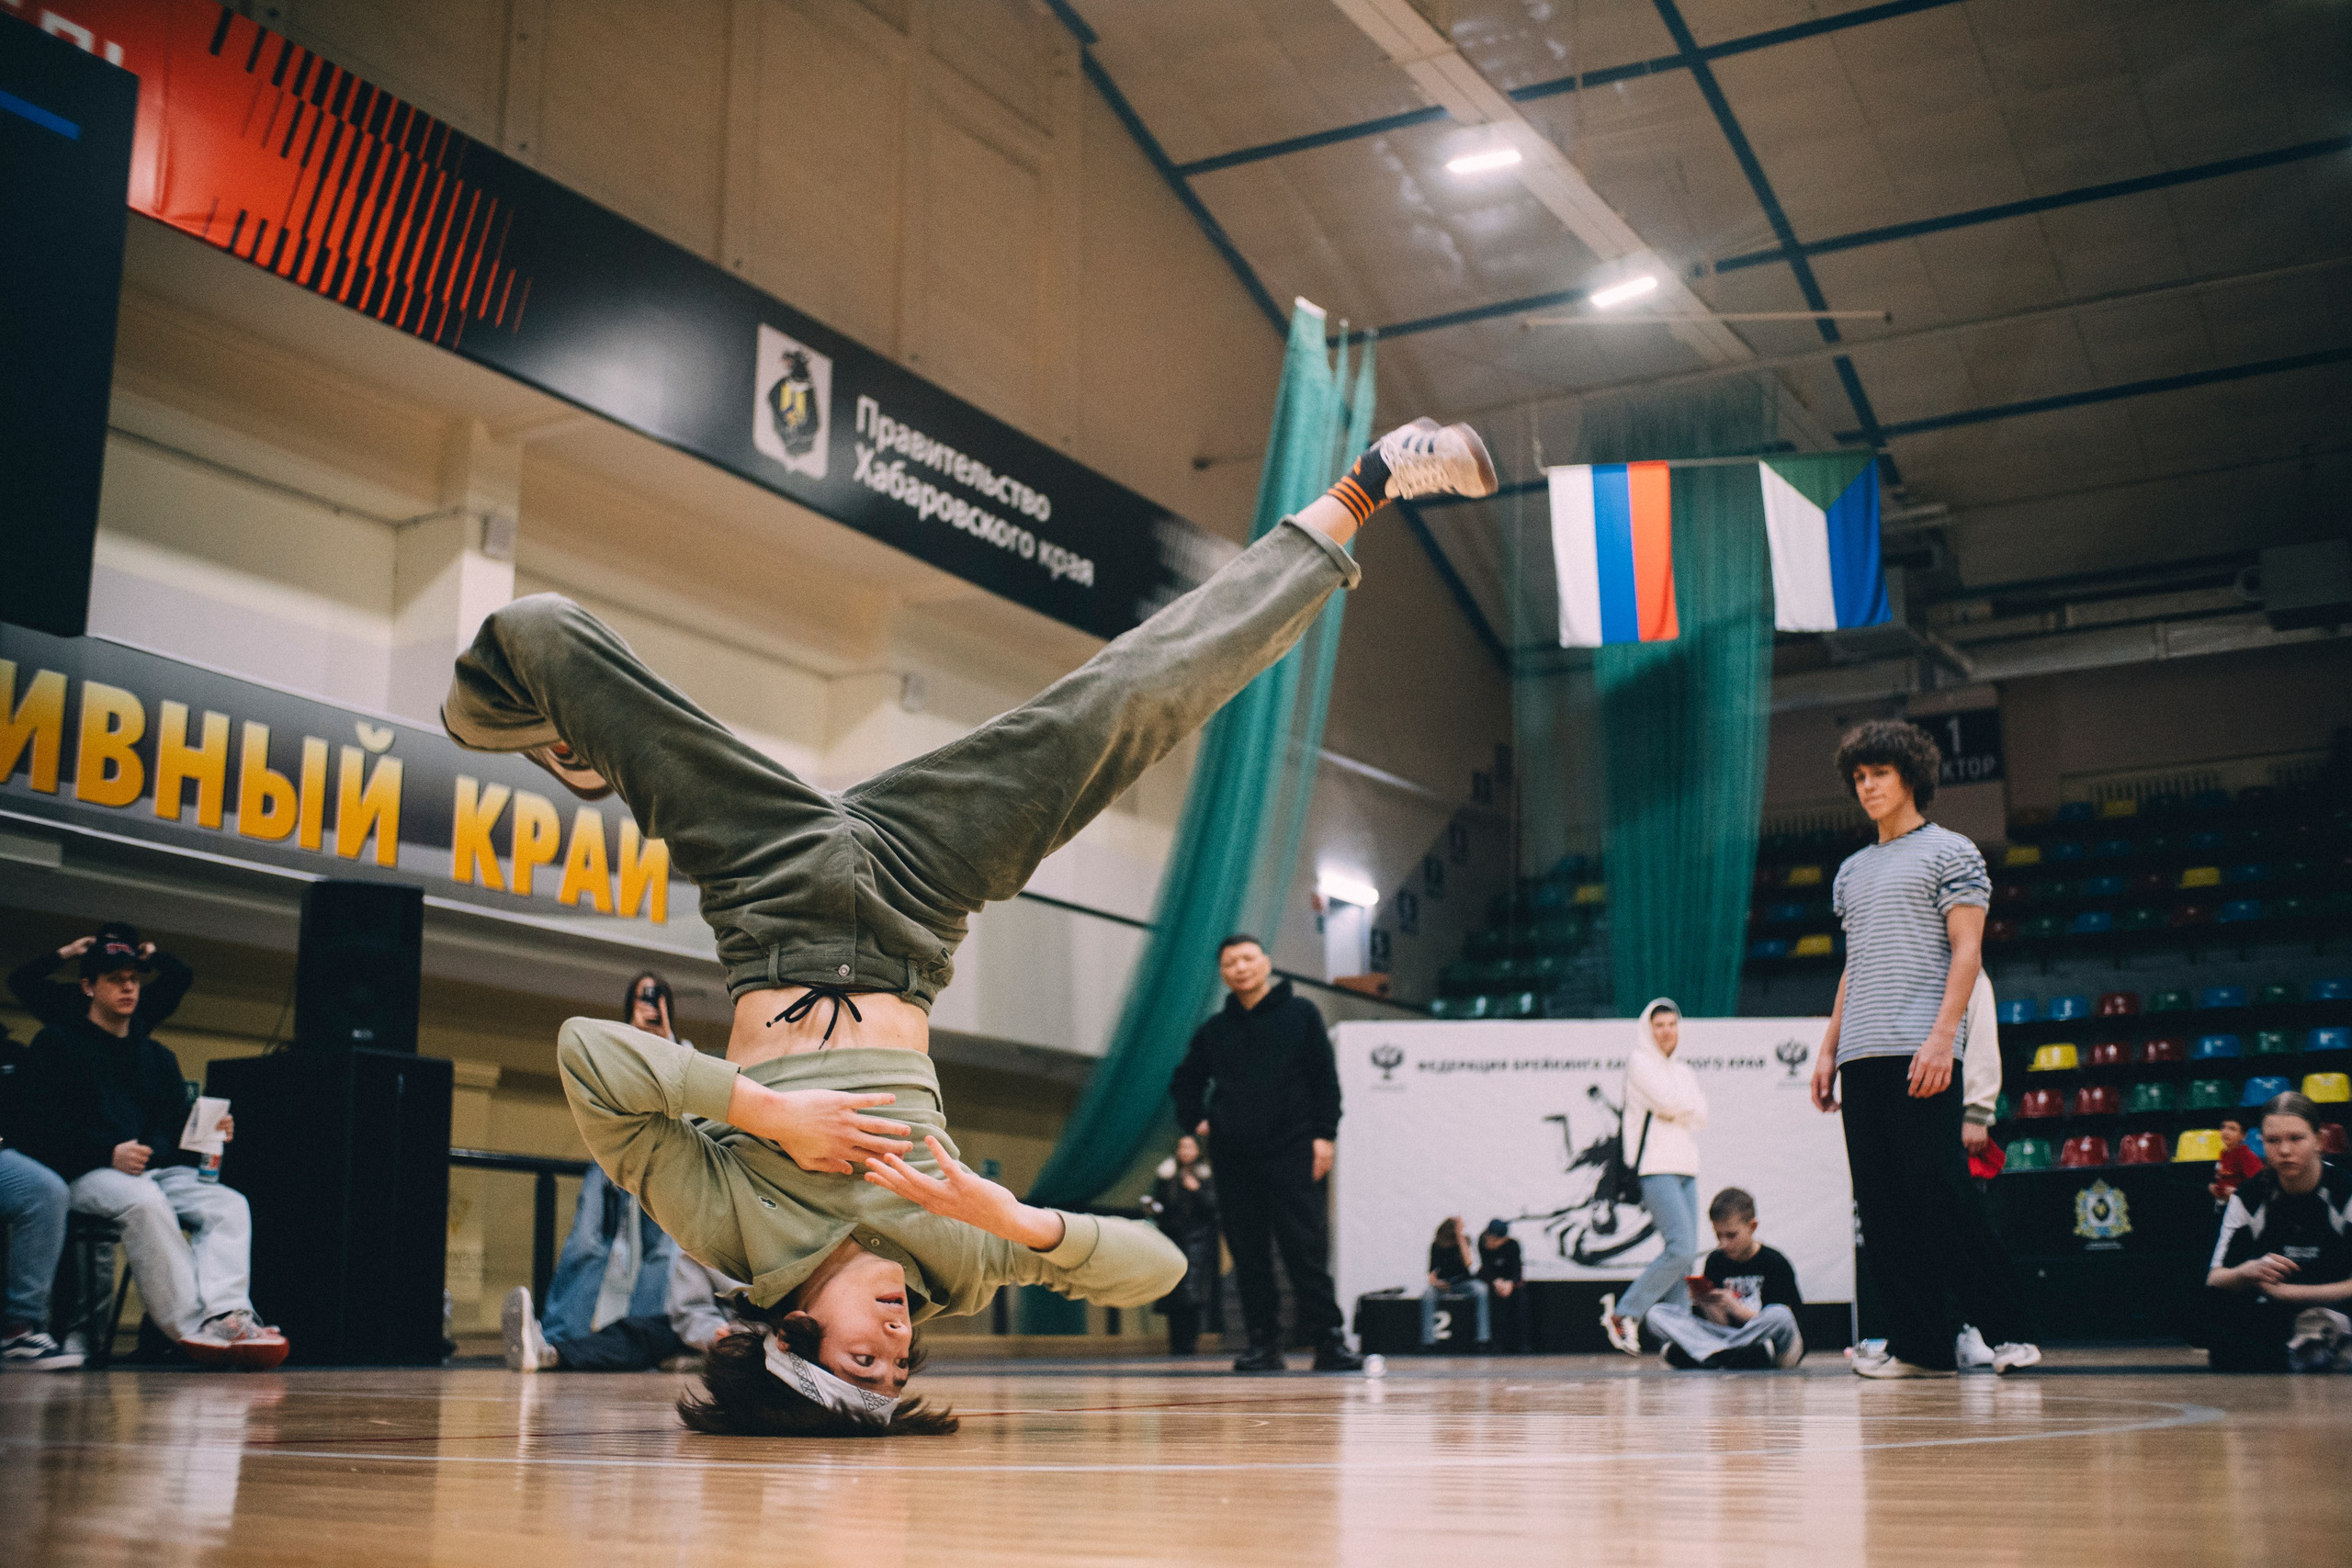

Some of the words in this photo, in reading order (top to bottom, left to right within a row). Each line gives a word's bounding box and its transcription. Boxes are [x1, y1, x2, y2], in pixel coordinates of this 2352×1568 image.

[855, 394, 1052, 523] Правительство
[853, 441, 1036, 559] Хабаровского
[1037, 539, 1094, 588] края
[1946, 717, 1961, 753] 1
[1940, 755, 1996, 780] КТОР
[1432, 1310, 1453, 1340] 2
